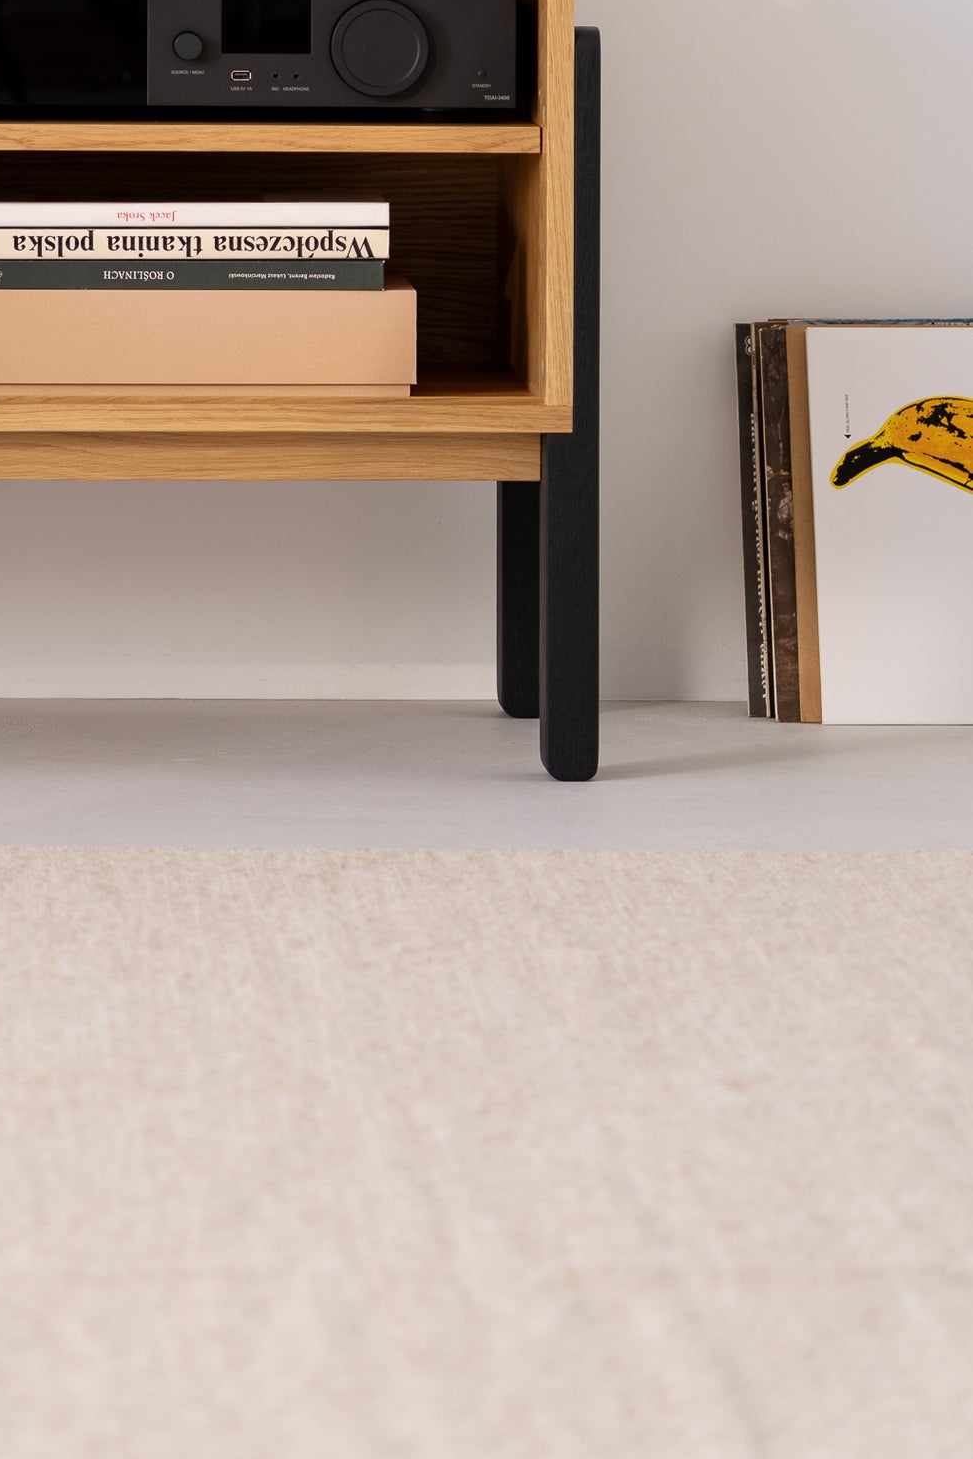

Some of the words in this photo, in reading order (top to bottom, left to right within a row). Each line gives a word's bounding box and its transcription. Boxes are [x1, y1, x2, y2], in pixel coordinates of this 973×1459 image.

[116, 212, 146, 222] Sroka
[149, 210, 177, 222] Jacek
[12, 230, 94, 258] polska
[106, 235, 203, 258] tkanina
[213, 230, 375, 258] Współczesna
[103, 270, 164, 283] ROŚLINACH
[166, 270, 175, 281] O
